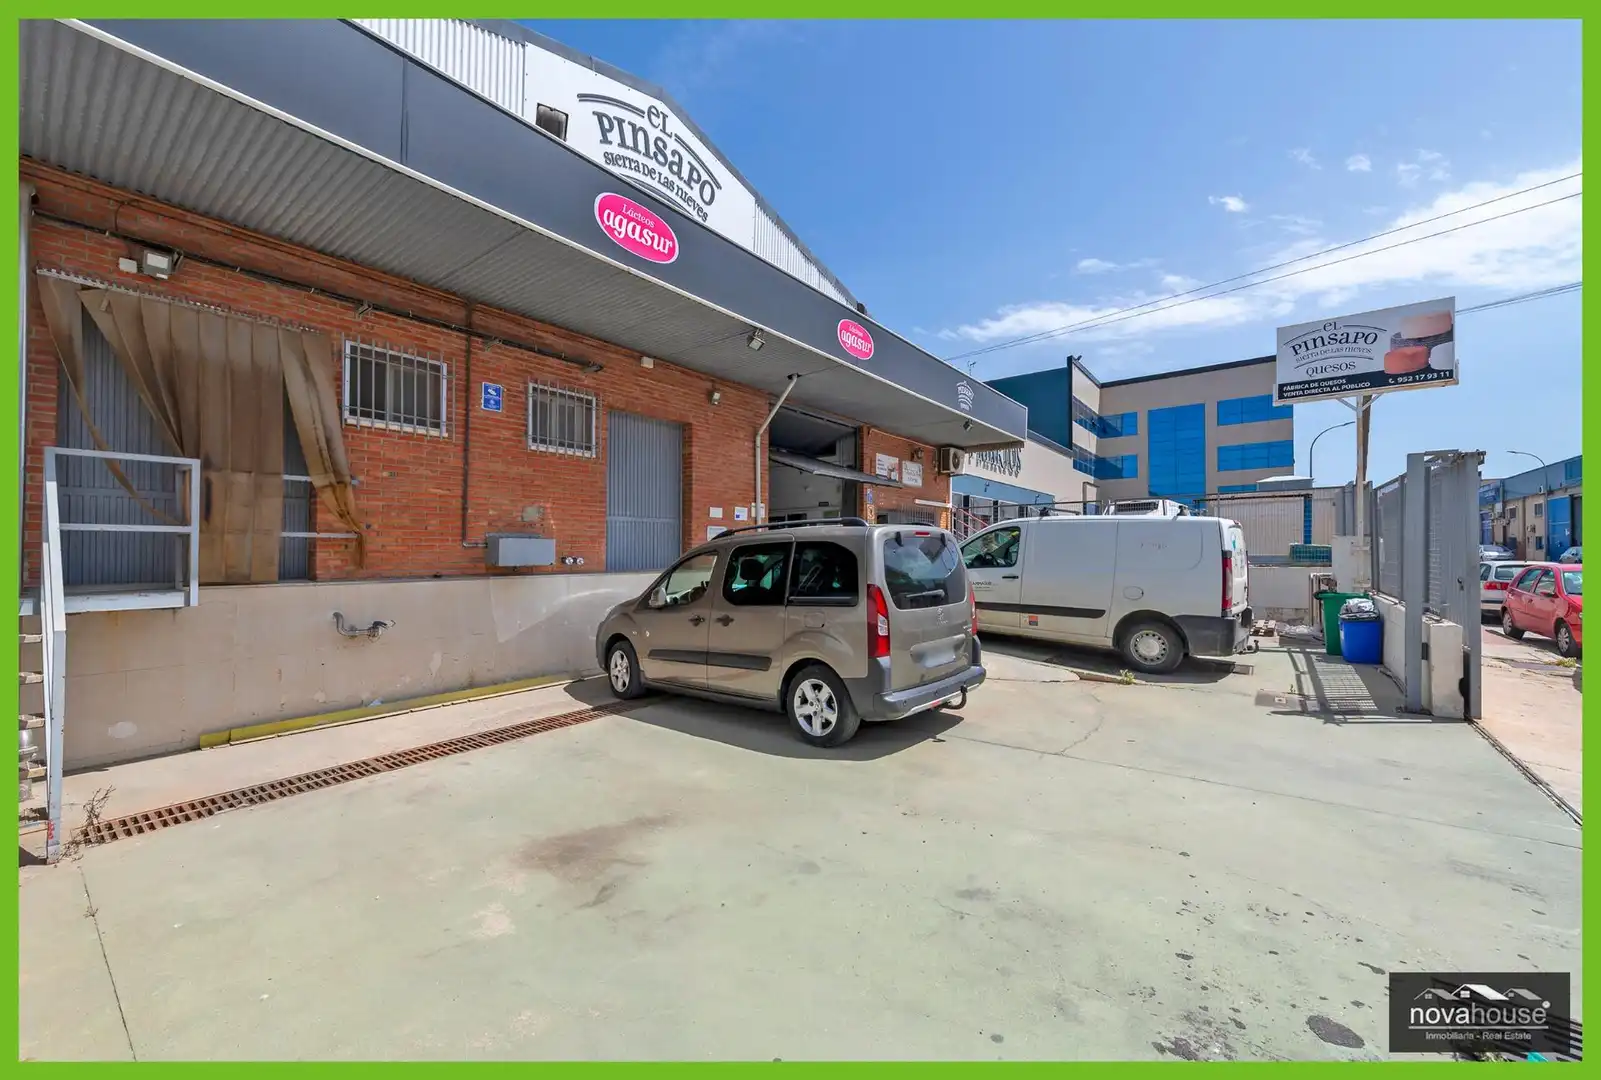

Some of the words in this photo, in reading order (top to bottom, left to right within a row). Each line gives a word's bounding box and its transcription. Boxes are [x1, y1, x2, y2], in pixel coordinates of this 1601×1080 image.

[622, 204, 655, 228] Lácteos
[603, 208, 673, 254] agasur
[841, 329, 872, 353] agasur
[1283, 383, 1309, 392] FÁBRICA
[1320, 379, 1347, 387] QUESOS
[1341, 381, 1371, 390] PÚBLICO
[1397, 375, 1413, 384] 952
[1427, 372, 1438, 380] 93
